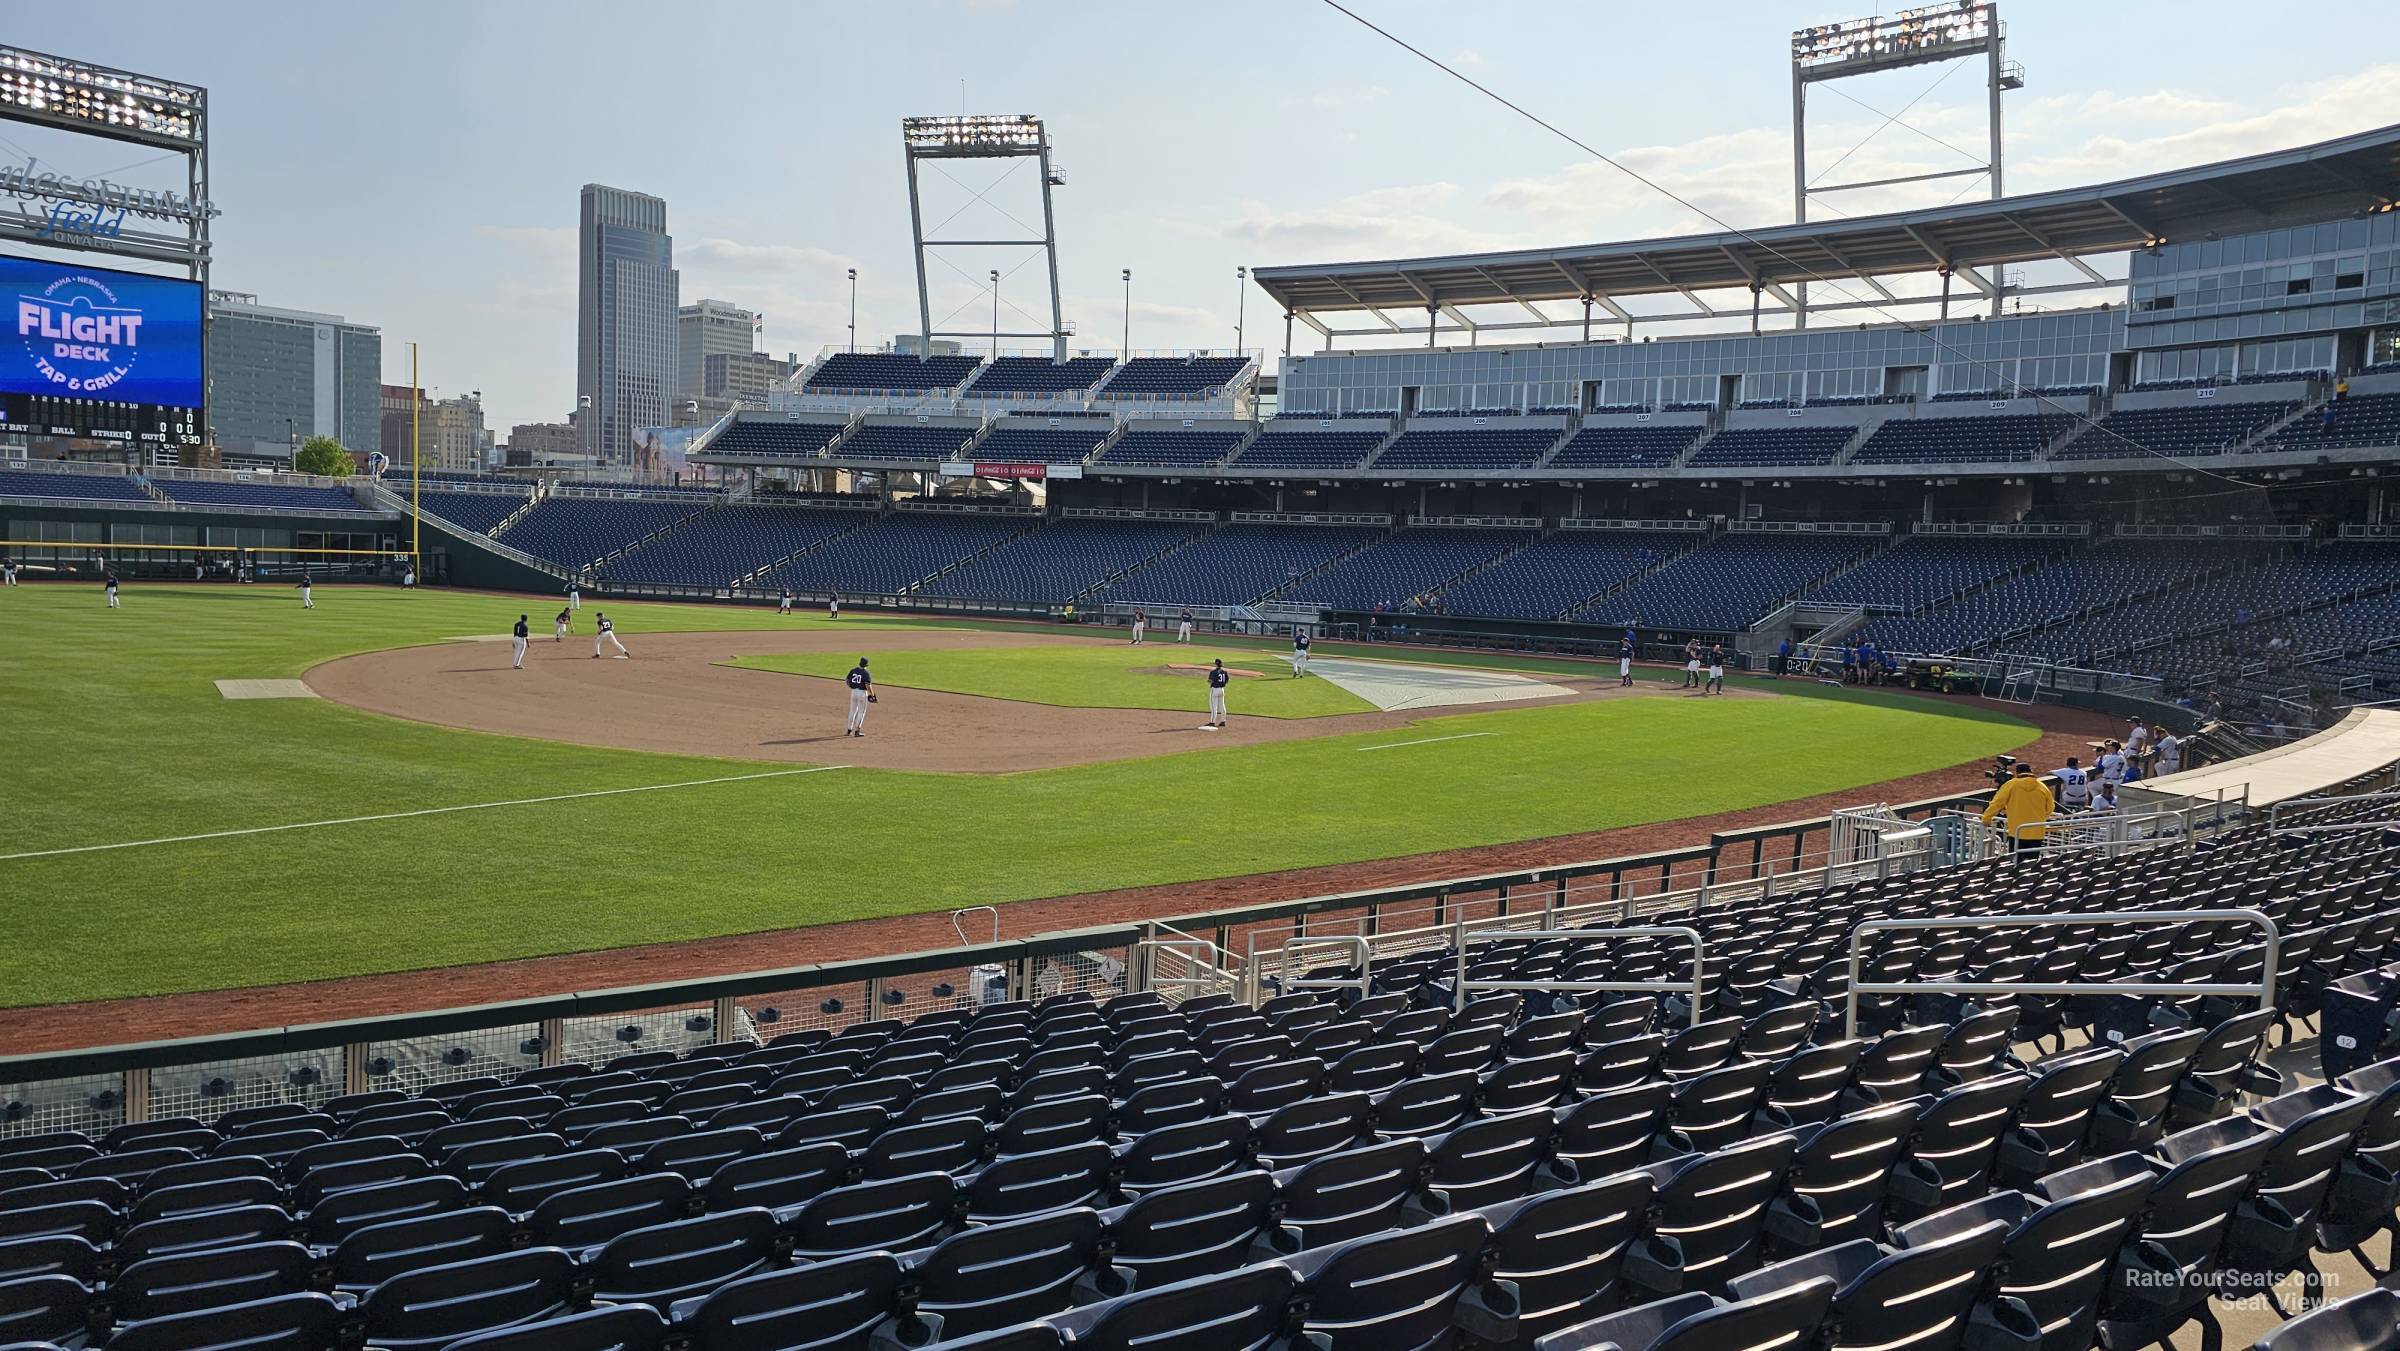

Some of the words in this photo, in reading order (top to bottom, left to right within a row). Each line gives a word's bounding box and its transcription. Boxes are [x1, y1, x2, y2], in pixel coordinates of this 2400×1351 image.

[1, 157, 72, 195] rles
[82, 179, 217, 220] SCHWAB
[35, 201, 126, 239] field
[54, 231, 116, 250] OMAHA
[44, 276, 71, 297] OMAHA
[77, 275, 118, 304] NEBRASKA
[18, 301, 142, 346] FLIGHT
[54, 343, 110, 362] DECK
[35, 356, 67, 384] TAP
[67, 377, 81, 390] &
[84, 365, 128, 391] GRILL
[187, 414, 193, 424] 0
[9, 423, 29, 432] BAT
[51, 426, 76, 435] BALL
[91, 429, 125, 438] STRIKE
[125, 430, 132, 440] 0
[141, 433, 160, 441] OUT
[159, 432, 166, 442] 0
[181, 435, 200, 445] 5:30
[160, 422, 167, 432] 0
[176, 423, 183, 433] 0
[187, 424, 193, 434] 0
[393, 553, 409, 562] 335
[851, 673, 862, 684] 20
[1217, 673, 1226, 682] 31
[2068, 775, 2085, 785] 28
[2111, 1032, 2120, 1040] 11
[2340, 1037, 2352, 1046] 12
